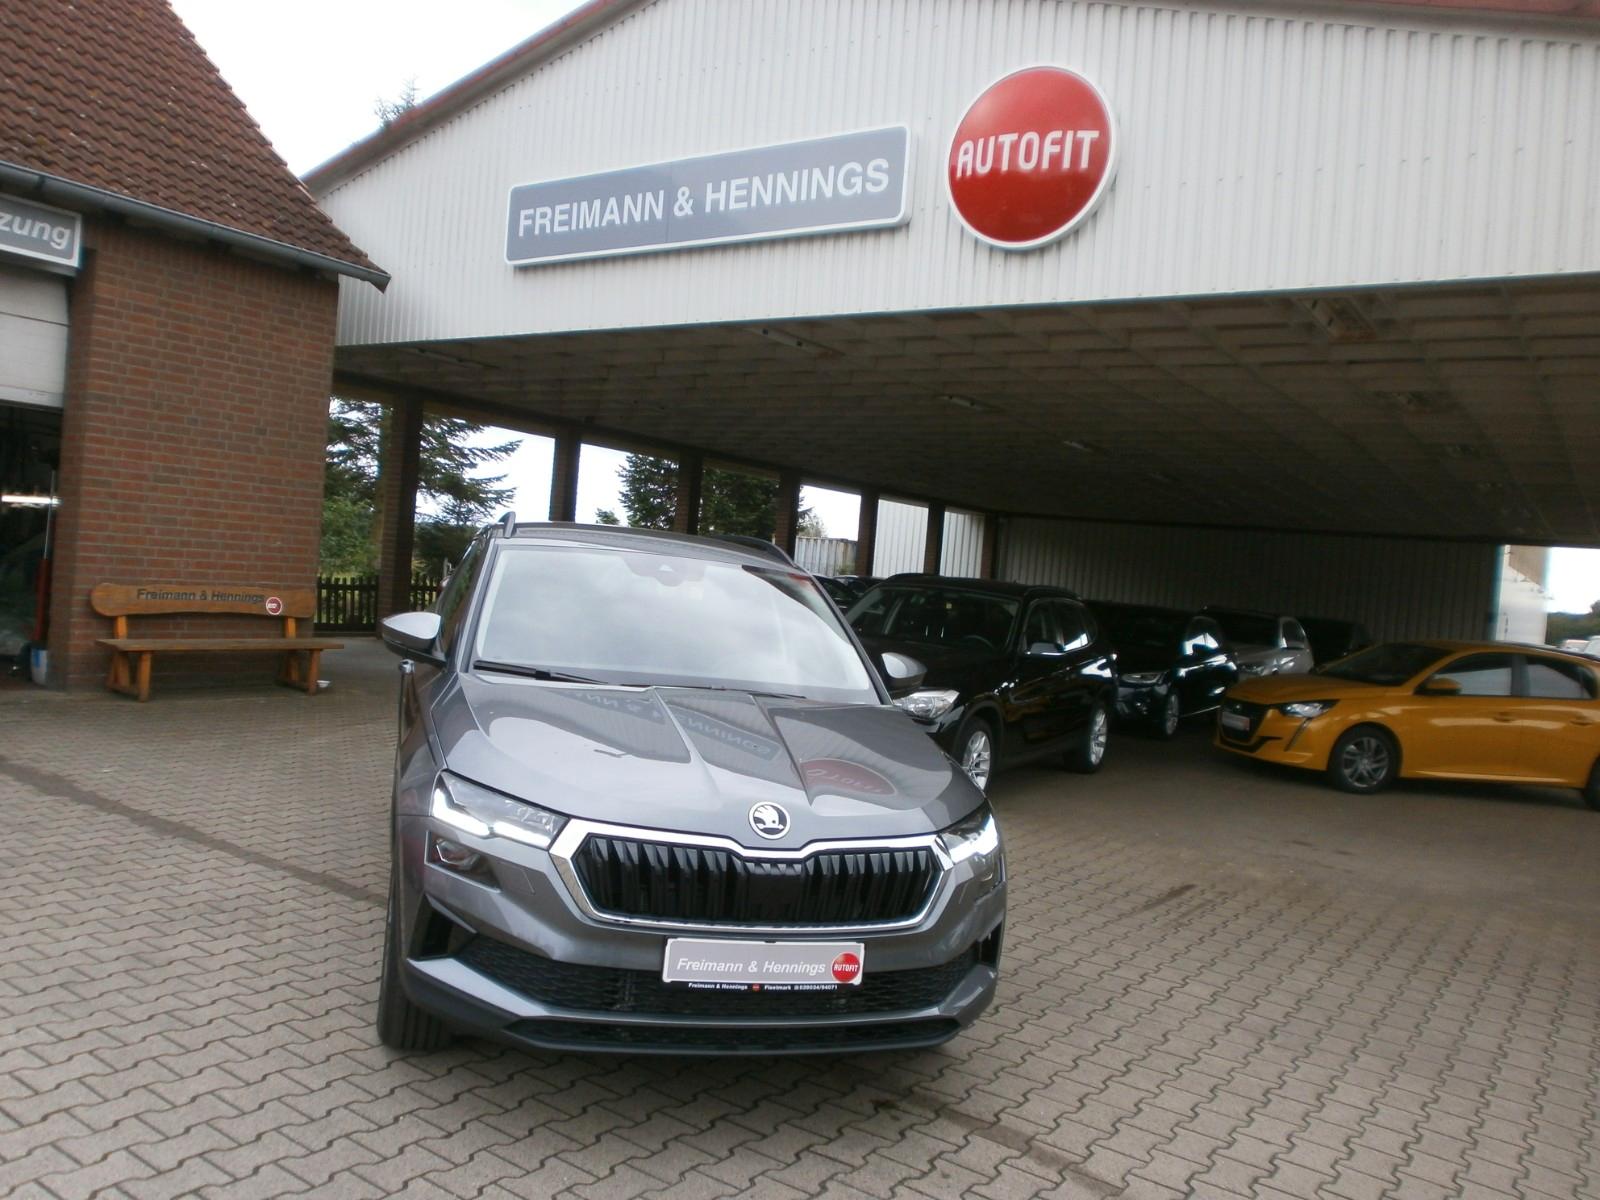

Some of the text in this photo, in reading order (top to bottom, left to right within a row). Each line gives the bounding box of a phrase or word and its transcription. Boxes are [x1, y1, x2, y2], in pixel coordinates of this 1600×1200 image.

[956, 130, 1100, 180] AUTOFIT
[518, 158, 890, 237] FREIMANN & HENNINGS
[0, 211, 71, 250] zung
[136, 588, 265, 604] Freimann & Hennings
[676, 958, 826, 976] Freimann & Hennings
[833, 964, 859, 973] AUTOFIT
